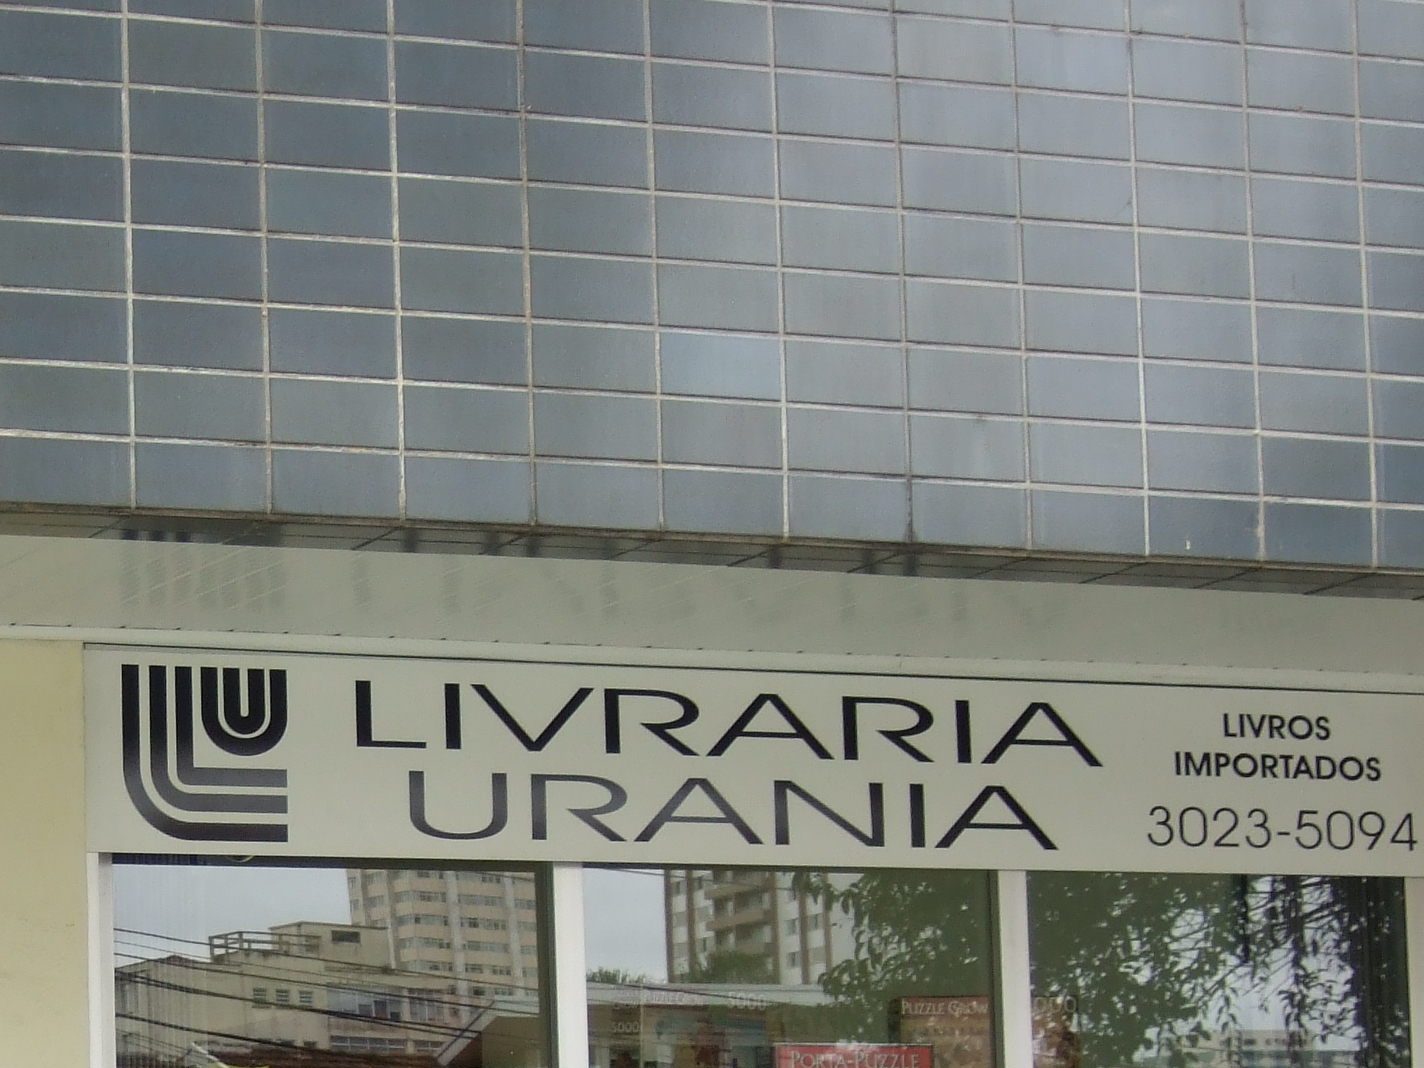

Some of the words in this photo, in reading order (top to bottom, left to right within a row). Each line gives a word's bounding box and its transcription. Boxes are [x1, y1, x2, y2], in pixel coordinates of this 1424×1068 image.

[355, 680, 1103, 767] LIVRARIA
[1223, 713, 1330, 741] LIVROS
[1175, 751, 1381, 782] IMPORTADOS
[408, 770, 1059, 850] URANIA
[1147, 806, 1418, 851] 3023-5094
